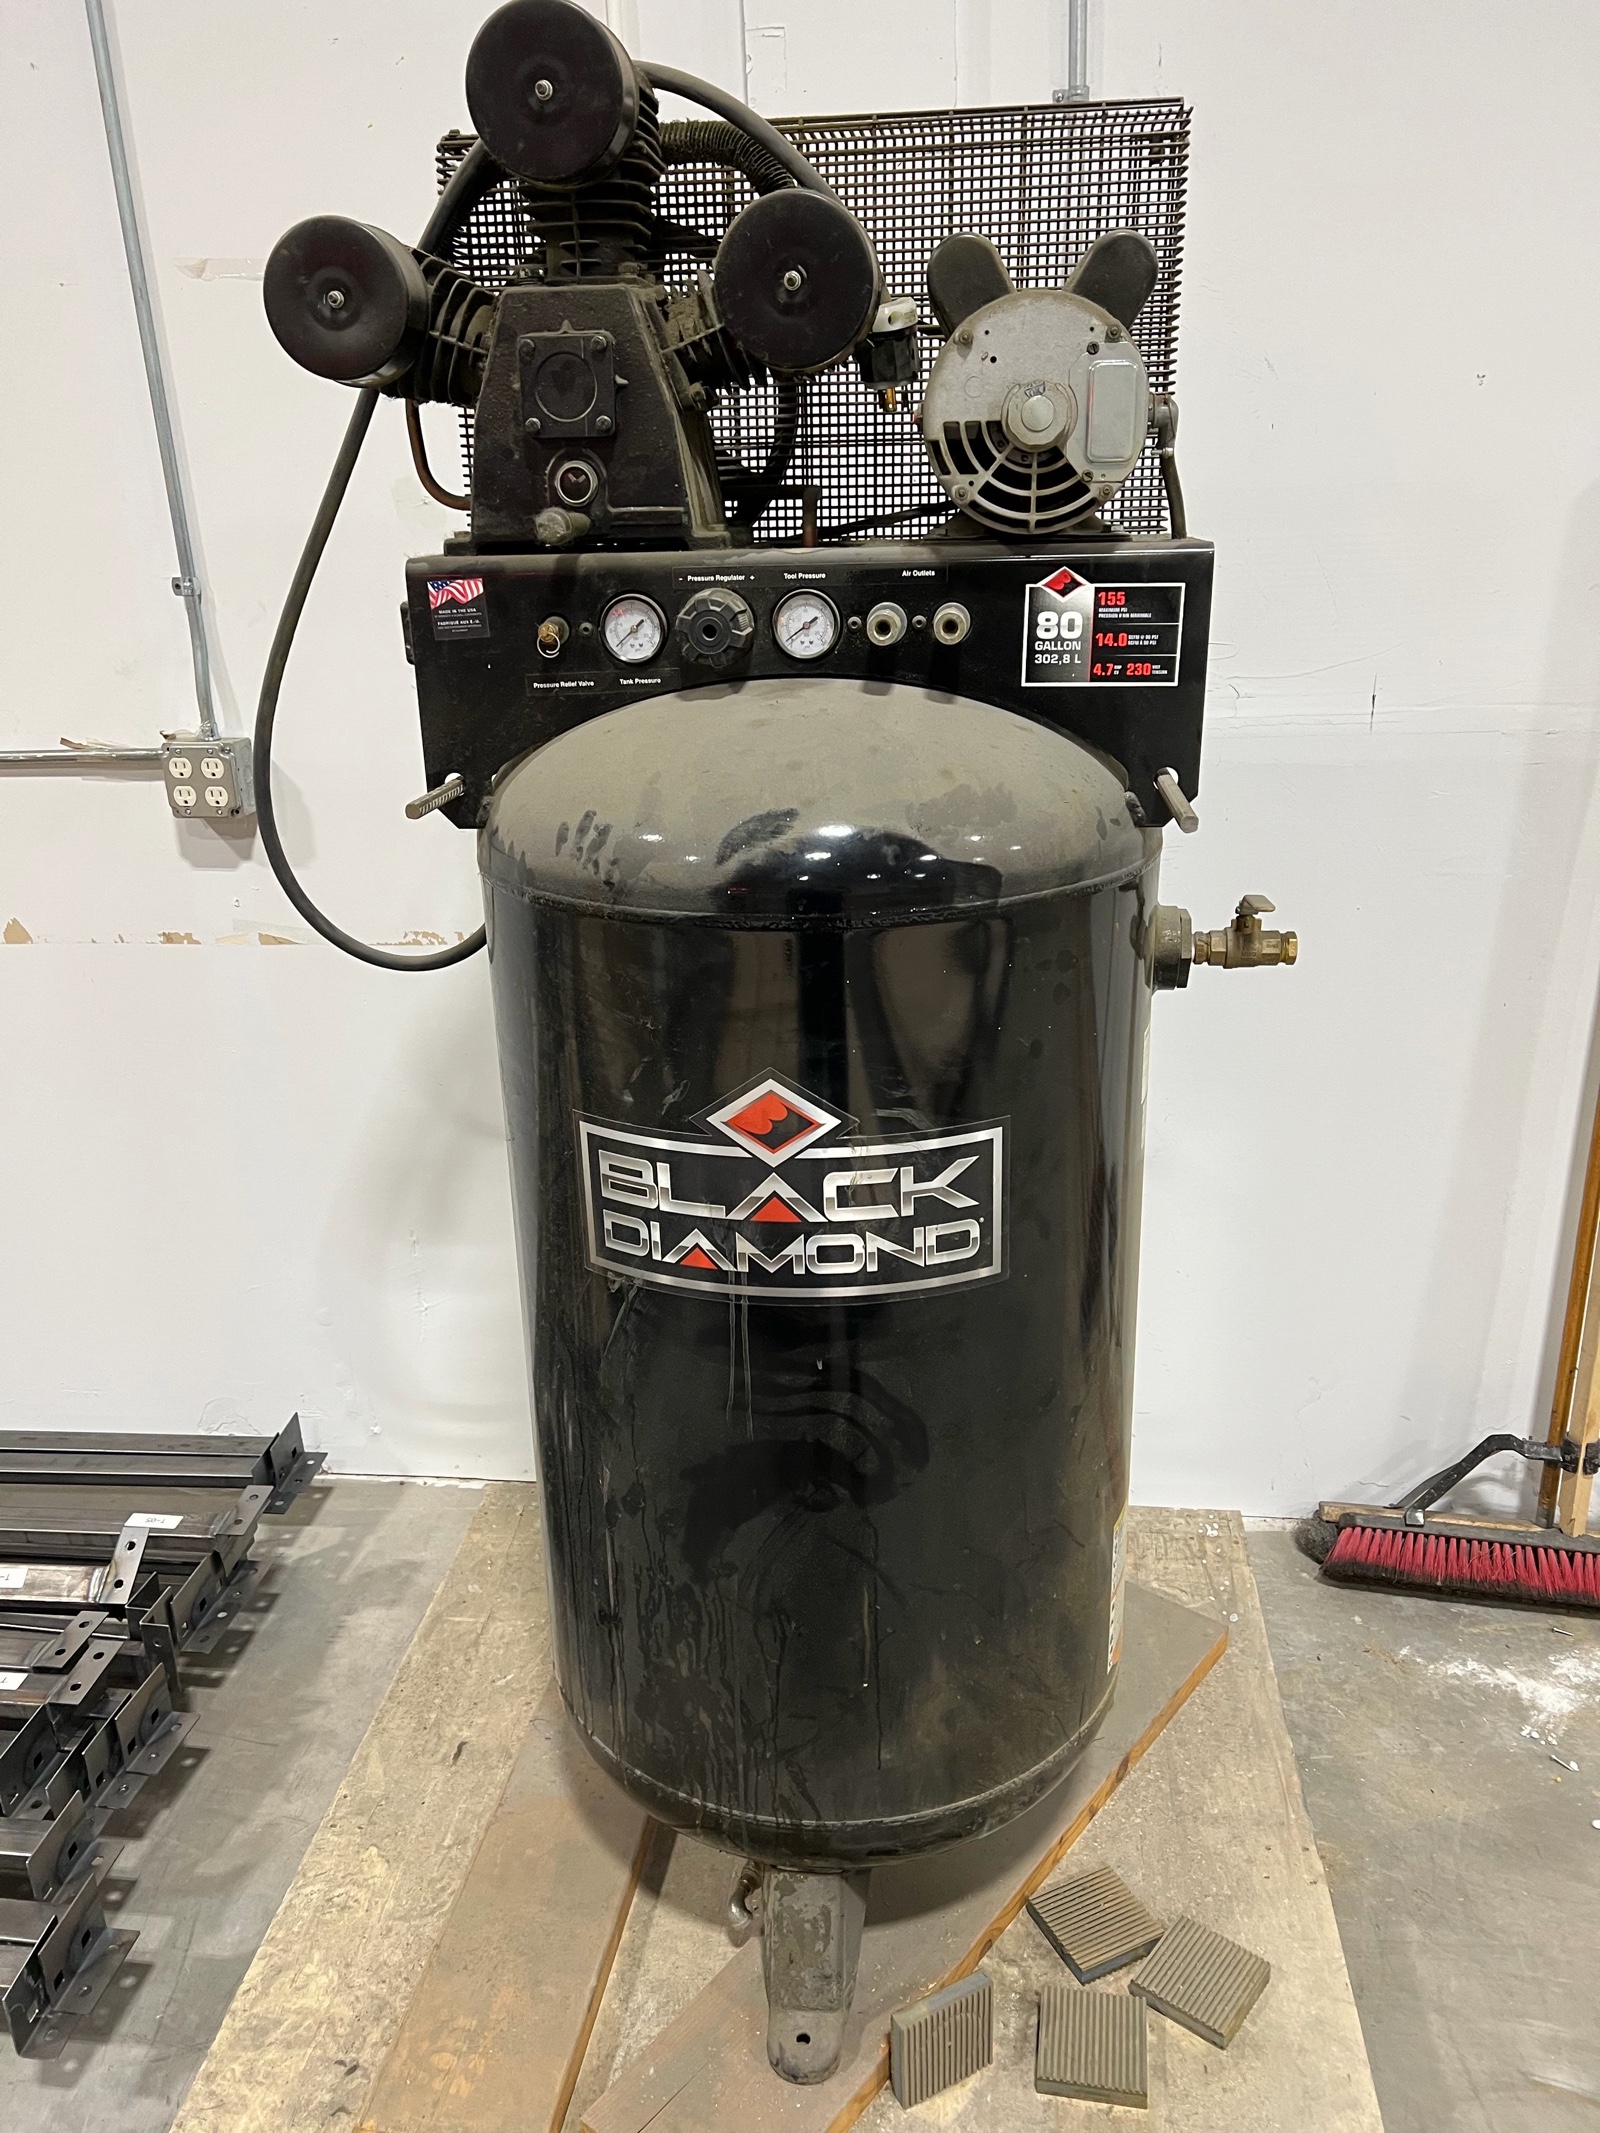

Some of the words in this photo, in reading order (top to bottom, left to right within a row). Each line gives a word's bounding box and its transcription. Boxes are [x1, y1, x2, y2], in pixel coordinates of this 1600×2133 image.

[715, 574, 746, 582] Regulator
[783, 572, 797, 580] Tool
[798, 572, 826, 580] Pressure
[902, 569, 911, 577] Air
[912, 569, 936, 577] Outlets
[1098, 591, 1126, 606] 155
[1036, 611, 1083, 639] 80
[1034, 641, 1082, 650] GALLON
[1095, 632, 1128, 647] 14.0
[1034, 653, 1071, 665] 302,8
[1074, 654, 1082, 664] L
[1093, 663, 1114, 676] 4.7
[1126, 663, 1152, 676] 230
[599, 1149, 980, 1222] BLACK
[602, 1208, 981, 1275] DIAMOND
